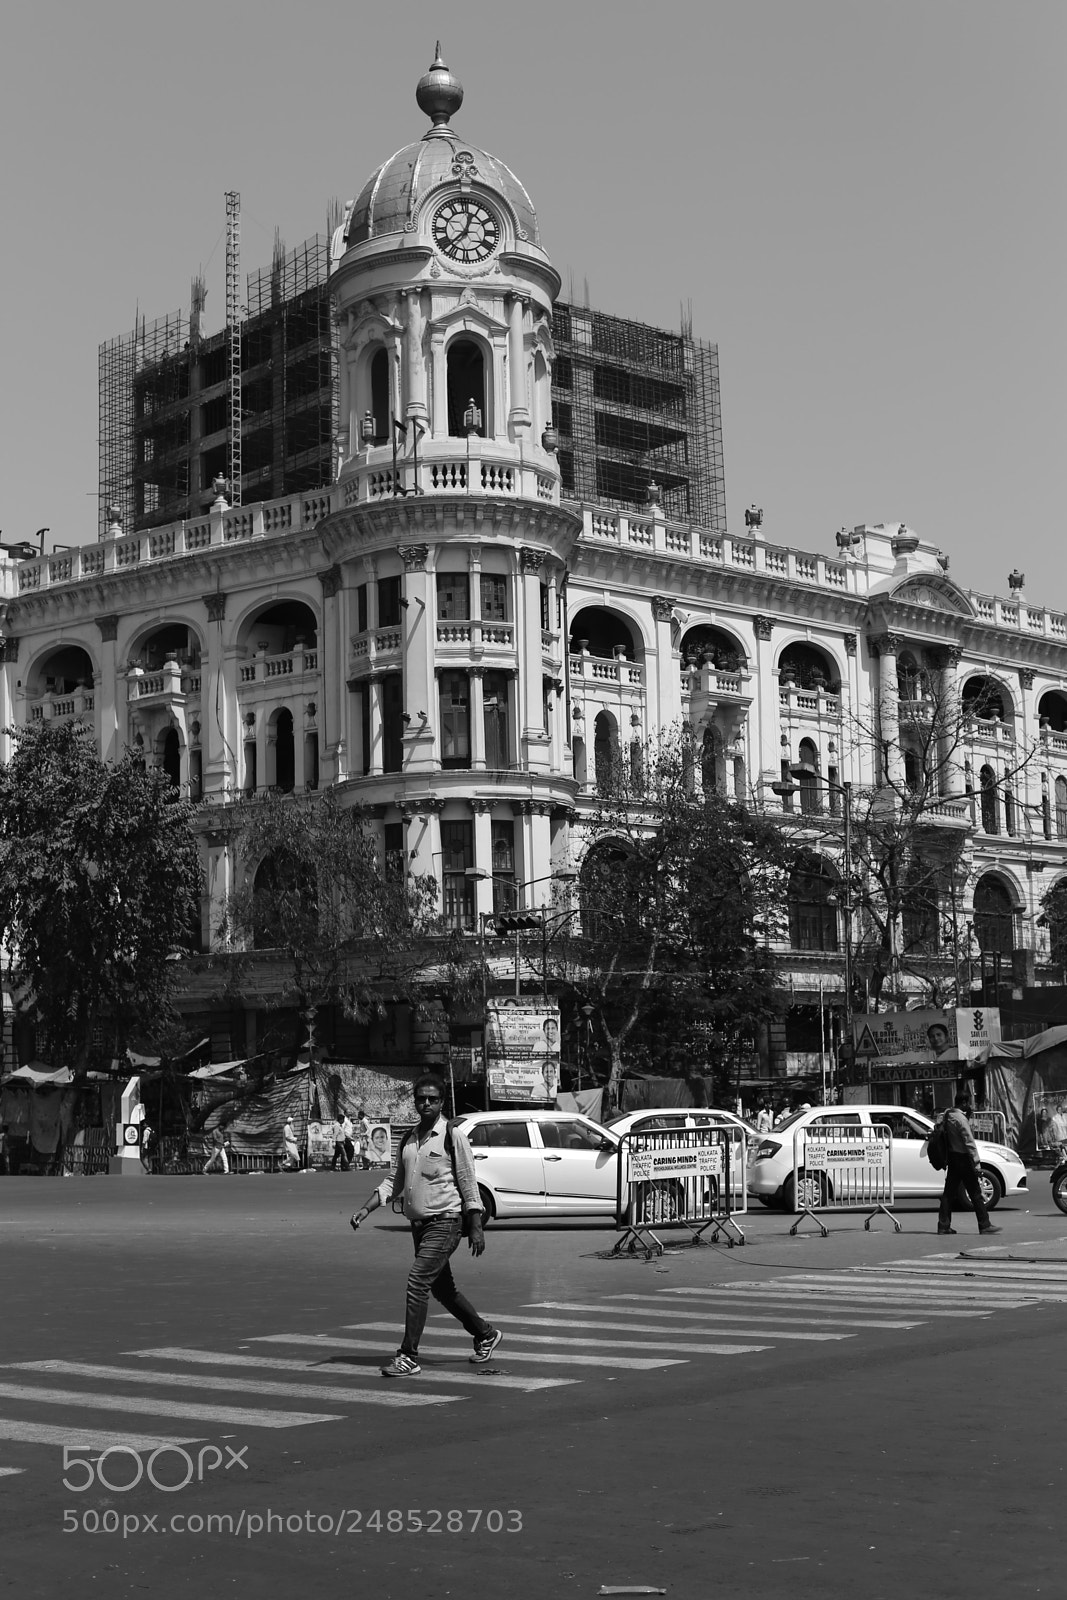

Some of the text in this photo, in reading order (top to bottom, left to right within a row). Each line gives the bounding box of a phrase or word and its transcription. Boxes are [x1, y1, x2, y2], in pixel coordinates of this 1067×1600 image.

[915, 1067, 955, 1079] POLICE
[698, 1149, 718, 1157] KOLKATA
[631, 1154, 652, 1162] KOLKATA
[653, 1155, 697, 1166] CARING MINDS
[699, 1157, 717, 1165] TRAFFIC
[632, 1162, 651, 1170] TRAFFIC
[700, 1164, 716, 1172] POLICE
[633, 1170, 650, 1178] POLICE
